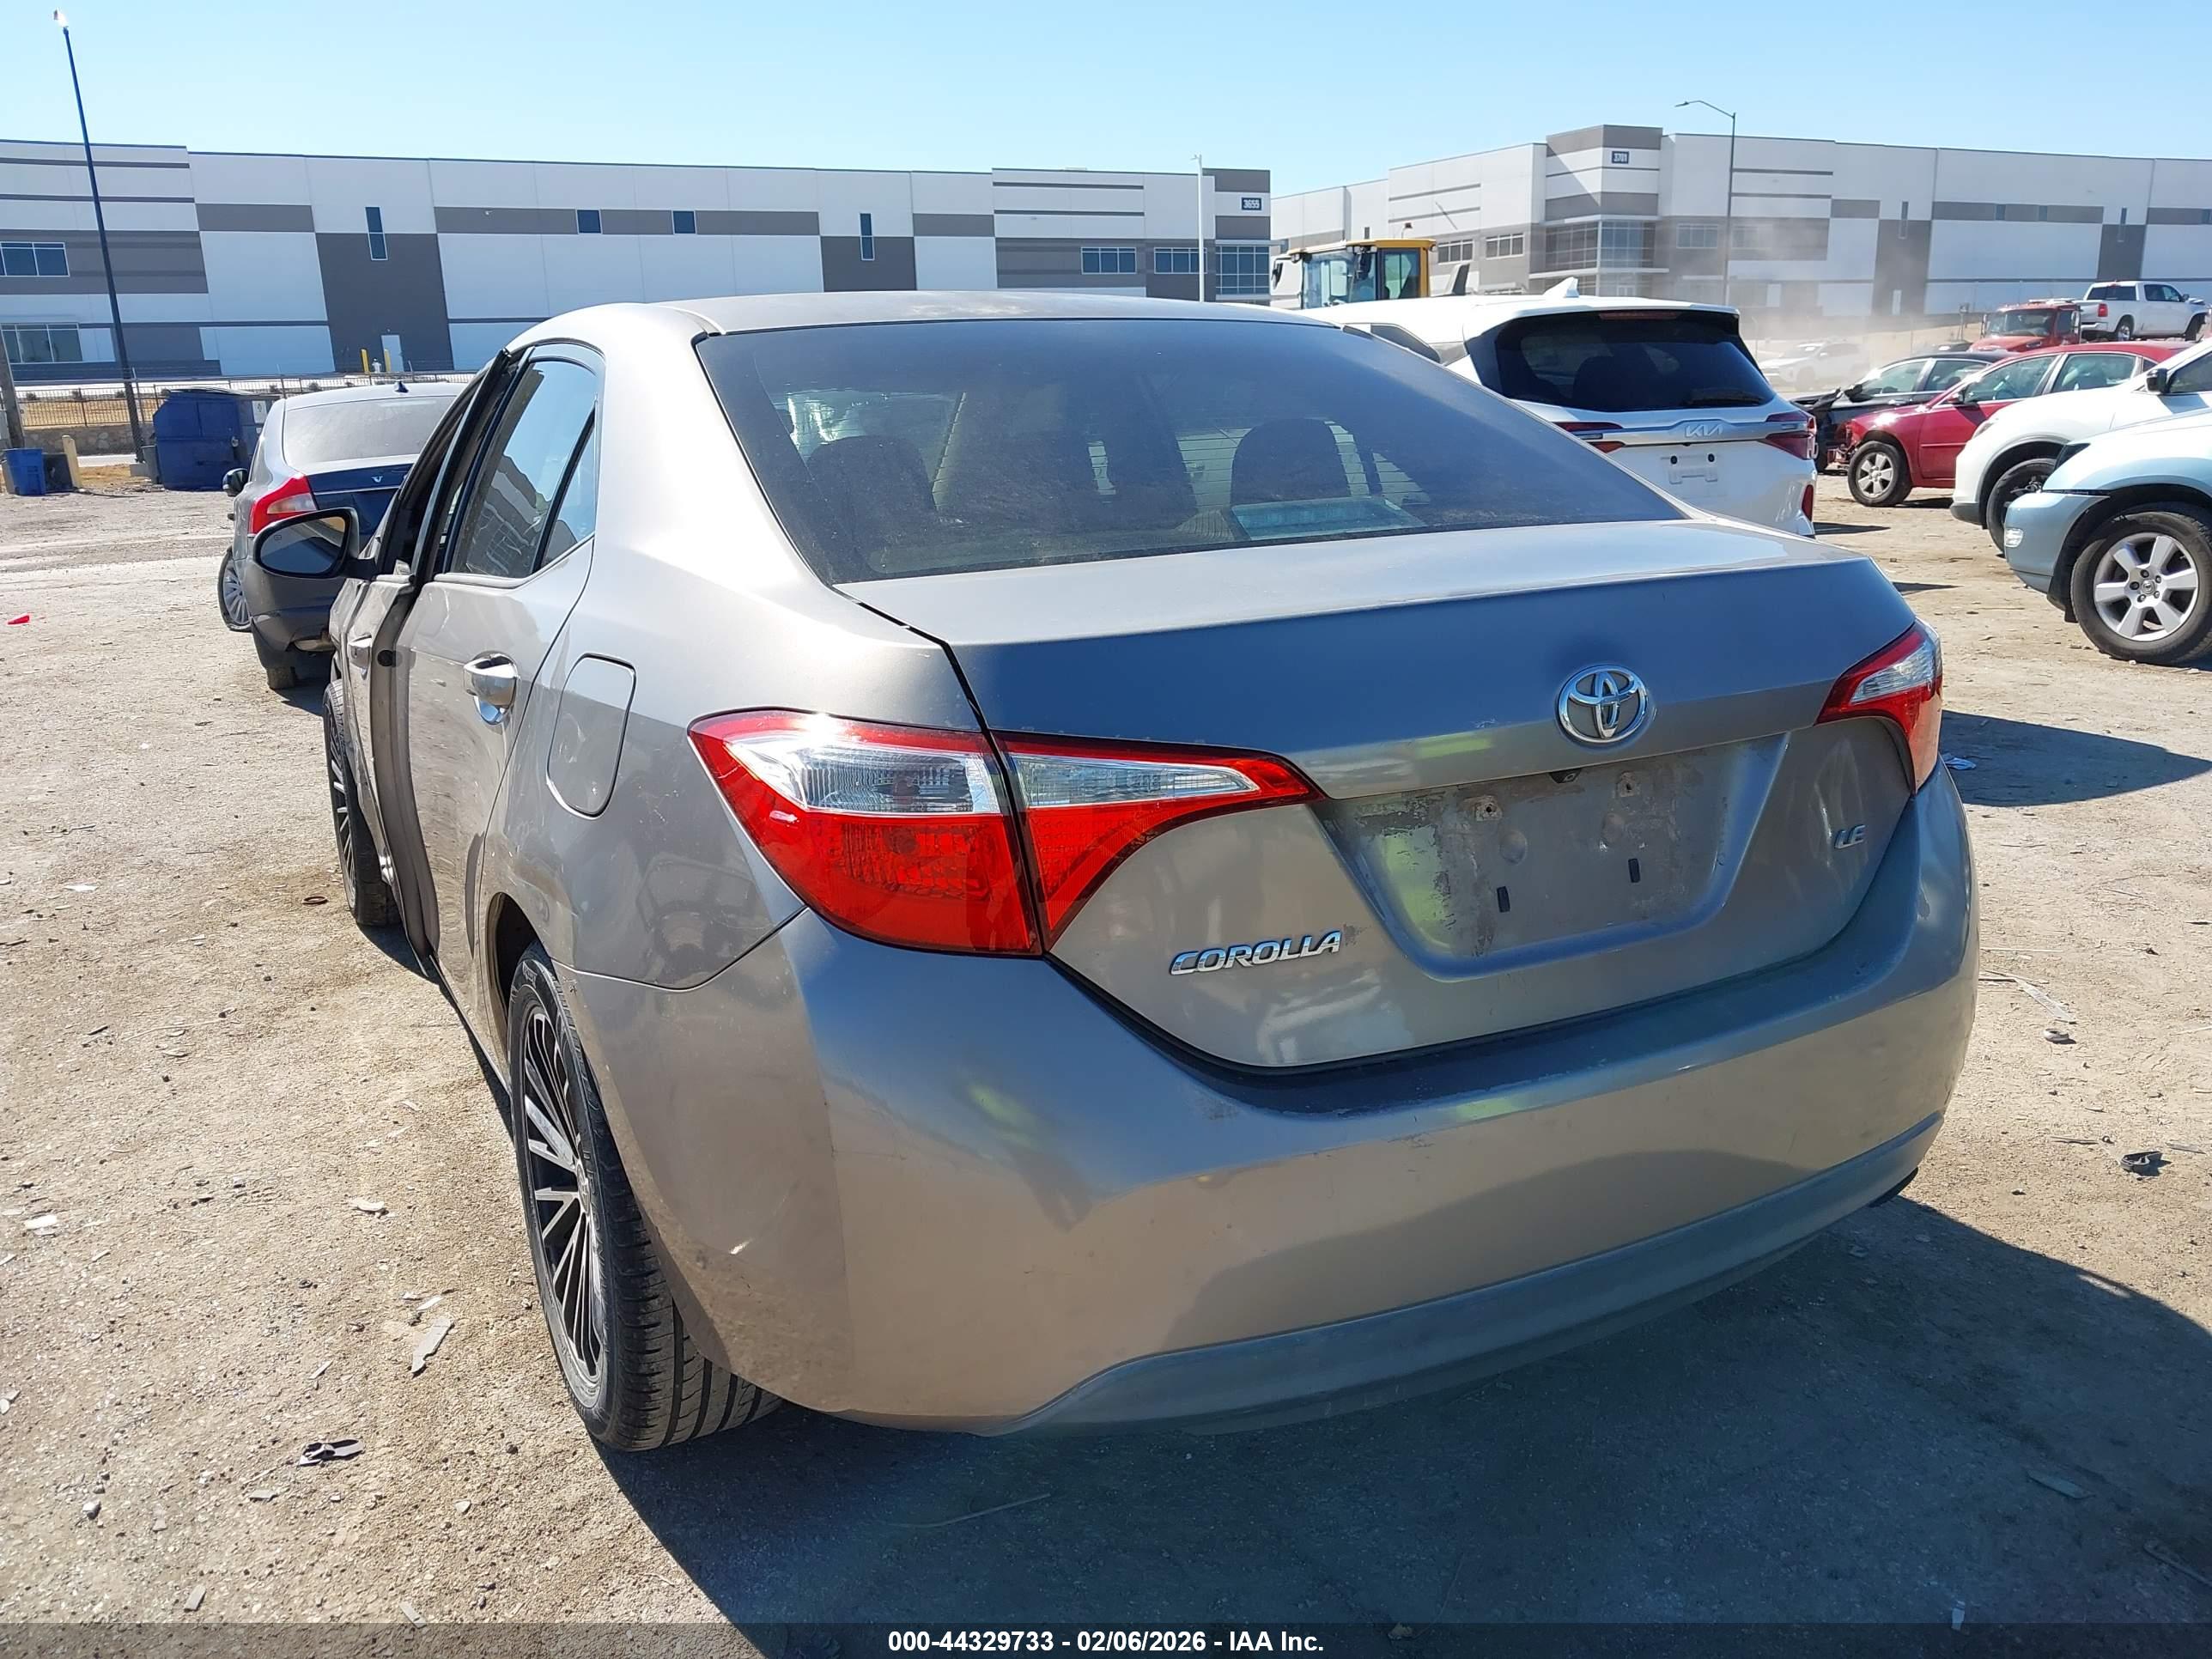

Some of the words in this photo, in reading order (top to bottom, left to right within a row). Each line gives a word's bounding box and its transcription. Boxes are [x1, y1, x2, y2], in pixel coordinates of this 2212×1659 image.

[1685, 423, 1723, 438] KIA
[1834, 824, 1866, 849] LE
[1170, 930, 1342, 975] COROLLA
